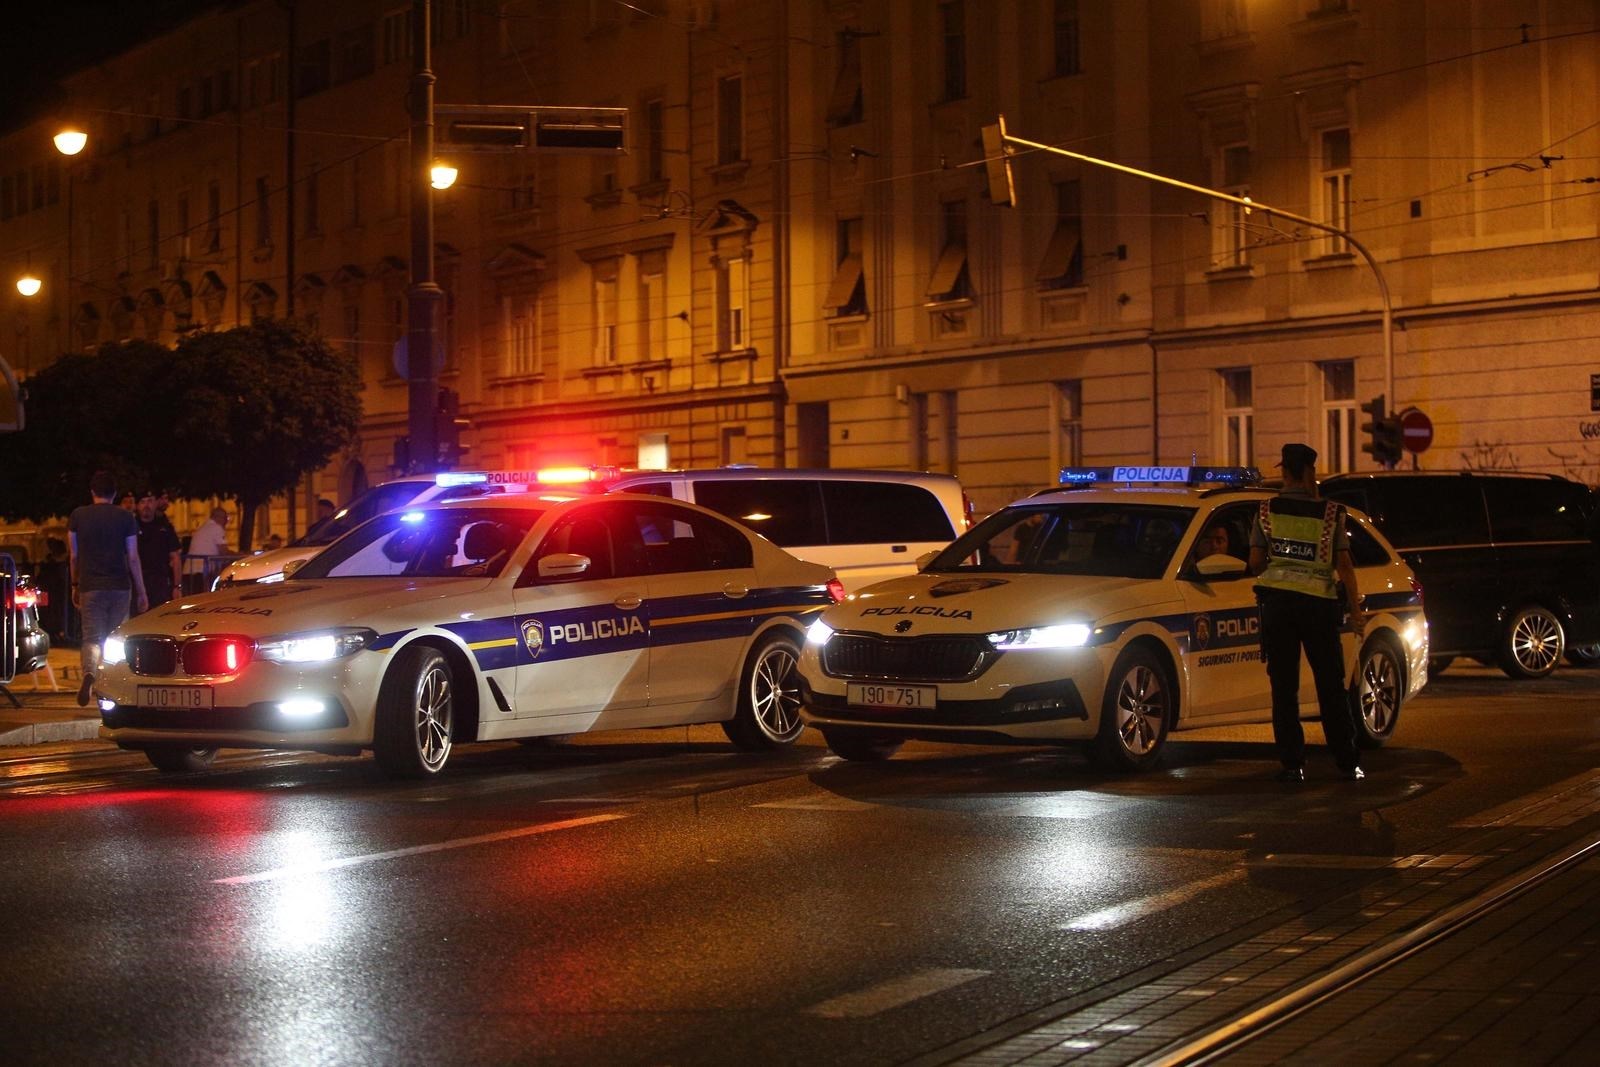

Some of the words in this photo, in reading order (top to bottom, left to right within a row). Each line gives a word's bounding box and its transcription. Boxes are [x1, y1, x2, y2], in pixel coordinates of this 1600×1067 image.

[488, 472, 538, 484] POLICIJA
[1116, 467, 1184, 481] POLICIJA
[860, 605, 973, 620] POLICIJA
[549, 616, 645, 645] POLICIJA
[1216, 617, 1259, 637] POLIC
[1198, 652, 1236, 666] SIGURNOST
[147, 689, 168, 706] 010
[180, 689, 201, 706] 118
[861, 686, 885, 704] 190
[896, 688, 922, 706] 751
